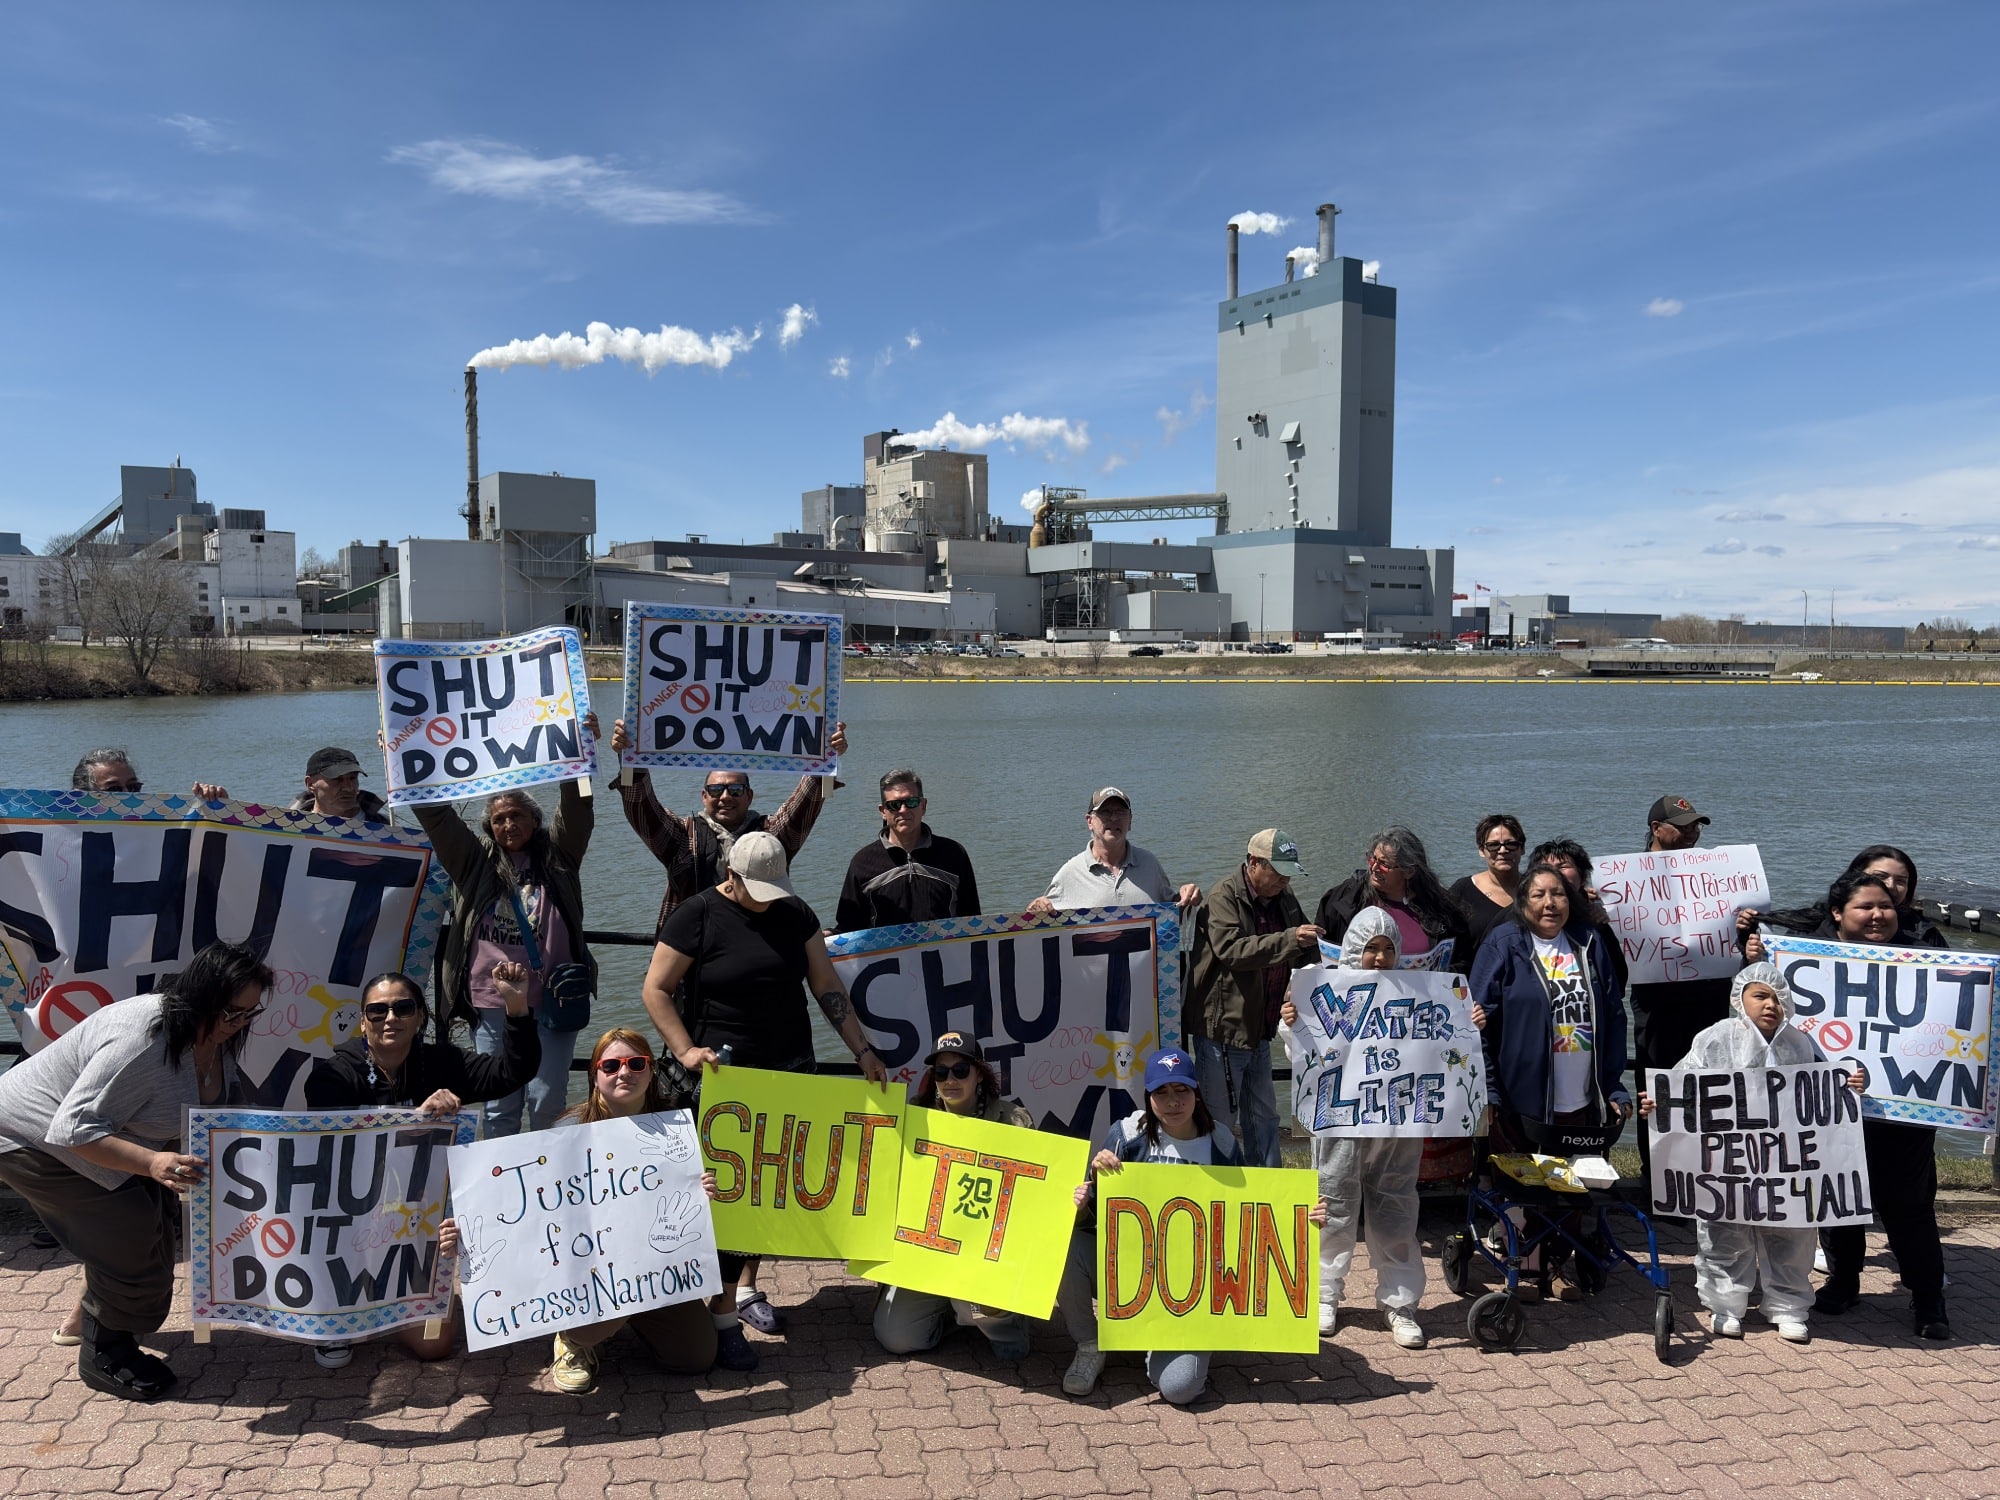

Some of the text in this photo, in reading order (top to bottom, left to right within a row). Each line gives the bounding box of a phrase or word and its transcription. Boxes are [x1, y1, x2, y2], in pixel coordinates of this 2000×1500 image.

[648, 623, 826, 687] SHUT
[1628, 661, 1731, 671] WELCOME
[386, 640, 567, 717] SHUT
[642, 682, 683, 716] DANGER
[713, 683, 751, 712] IT
[387, 716, 426, 752] DANGER
[461, 710, 499, 741] IT
[654, 713, 824, 755] DOWN
[401, 719, 581, 786] DOWN
[1600, 860, 1628, 877] SAY
[1639, 855, 1655, 872] NO
[1659, 855, 1678, 869] TO
[0, 827, 423, 988] SHUT
[1600, 879, 1646, 906] SAY
[1650, 874, 1671, 901] NO
[1671, 874, 1701, 899] TO
[1657, 905, 1689, 926] OUR
[1648, 936, 1689, 963] YES
[1690, 932, 1715, 957] TO
[1719, 927, 1739, 958] He
[1664, 960, 1700, 982] US
[850, 927, 1151, 1069] SHUT
[1783, 958, 1991, 1032] SHUT
[1858, 1020, 1900, 1053] IT
[1313, 1064, 1445, 1131] LIFE
[1654, 1068, 1858, 1133] HELP OUR
[700, 1101, 898, 1216] SHUT
[1562, 1135, 1605, 1147] nexus
[1701, 1130, 1820, 1175] PEOPLE
[221, 1128, 454, 1216] SHUT
[492, 1148, 663, 1224] Justice
[894, 1138, 1048, 1262] IT
[952, 1172, 993, 1220] 怨
[215, 1213, 262, 1257] DANGER
[300, 1216, 352, 1255] IT
[540, 1223, 612, 1265] for
[232, 1240, 437, 1308] DOWN
[1105, 1196, 1309, 1319] DOWN
